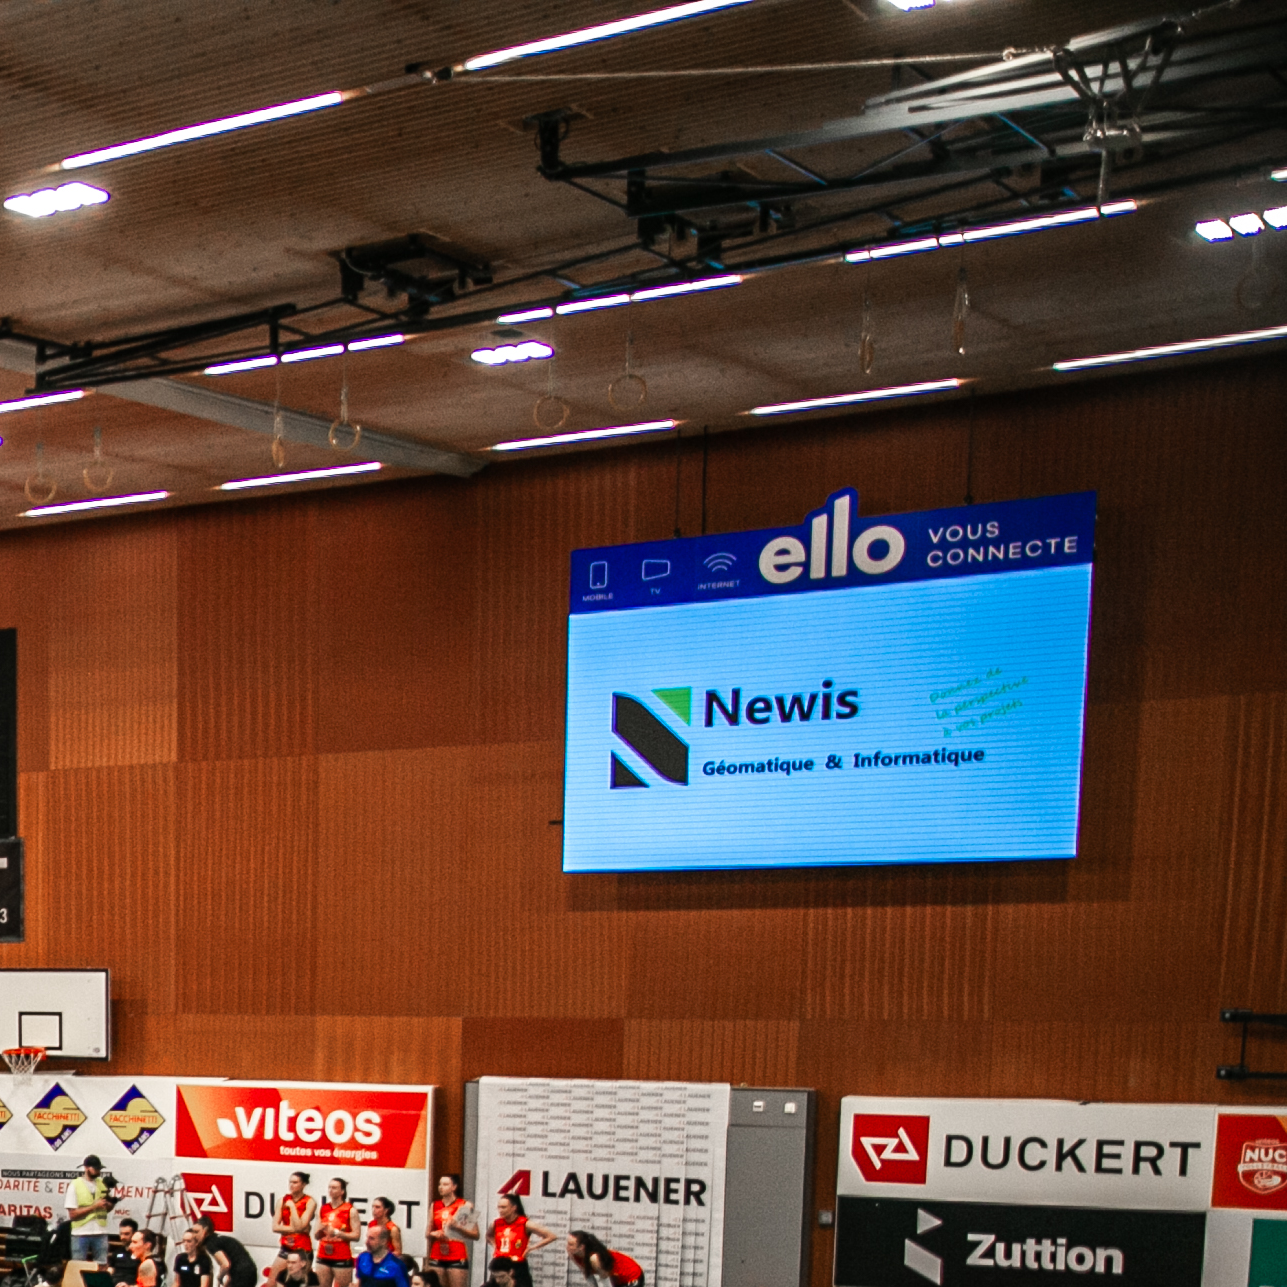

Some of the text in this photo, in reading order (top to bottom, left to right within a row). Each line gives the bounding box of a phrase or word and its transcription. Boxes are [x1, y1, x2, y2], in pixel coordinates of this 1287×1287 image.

[758, 494, 905, 584] ello
[929, 521, 999, 543] VOUS
[927, 536, 1078, 567] CONNECTE
[697, 580, 740, 590] INTERNET
[704, 681, 859, 728] Newis
[702, 747, 984, 777] Géomatique & Informatique
[34, 1112, 80, 1121] FACCHINETTI
[109, 1115, 157, 1124] FACCHINETTI
[235, 1100, 382, 1145] viteos
[280, 1145, 378, 1161] toutes vos énergies
[943, 1134, 1201, 1177] DUCKERT
[45, 1182, 53, 1193] &
[542, 1170, 706, 1207] LAUENER
[966, 1233, 1124, 1275] Zuttion
